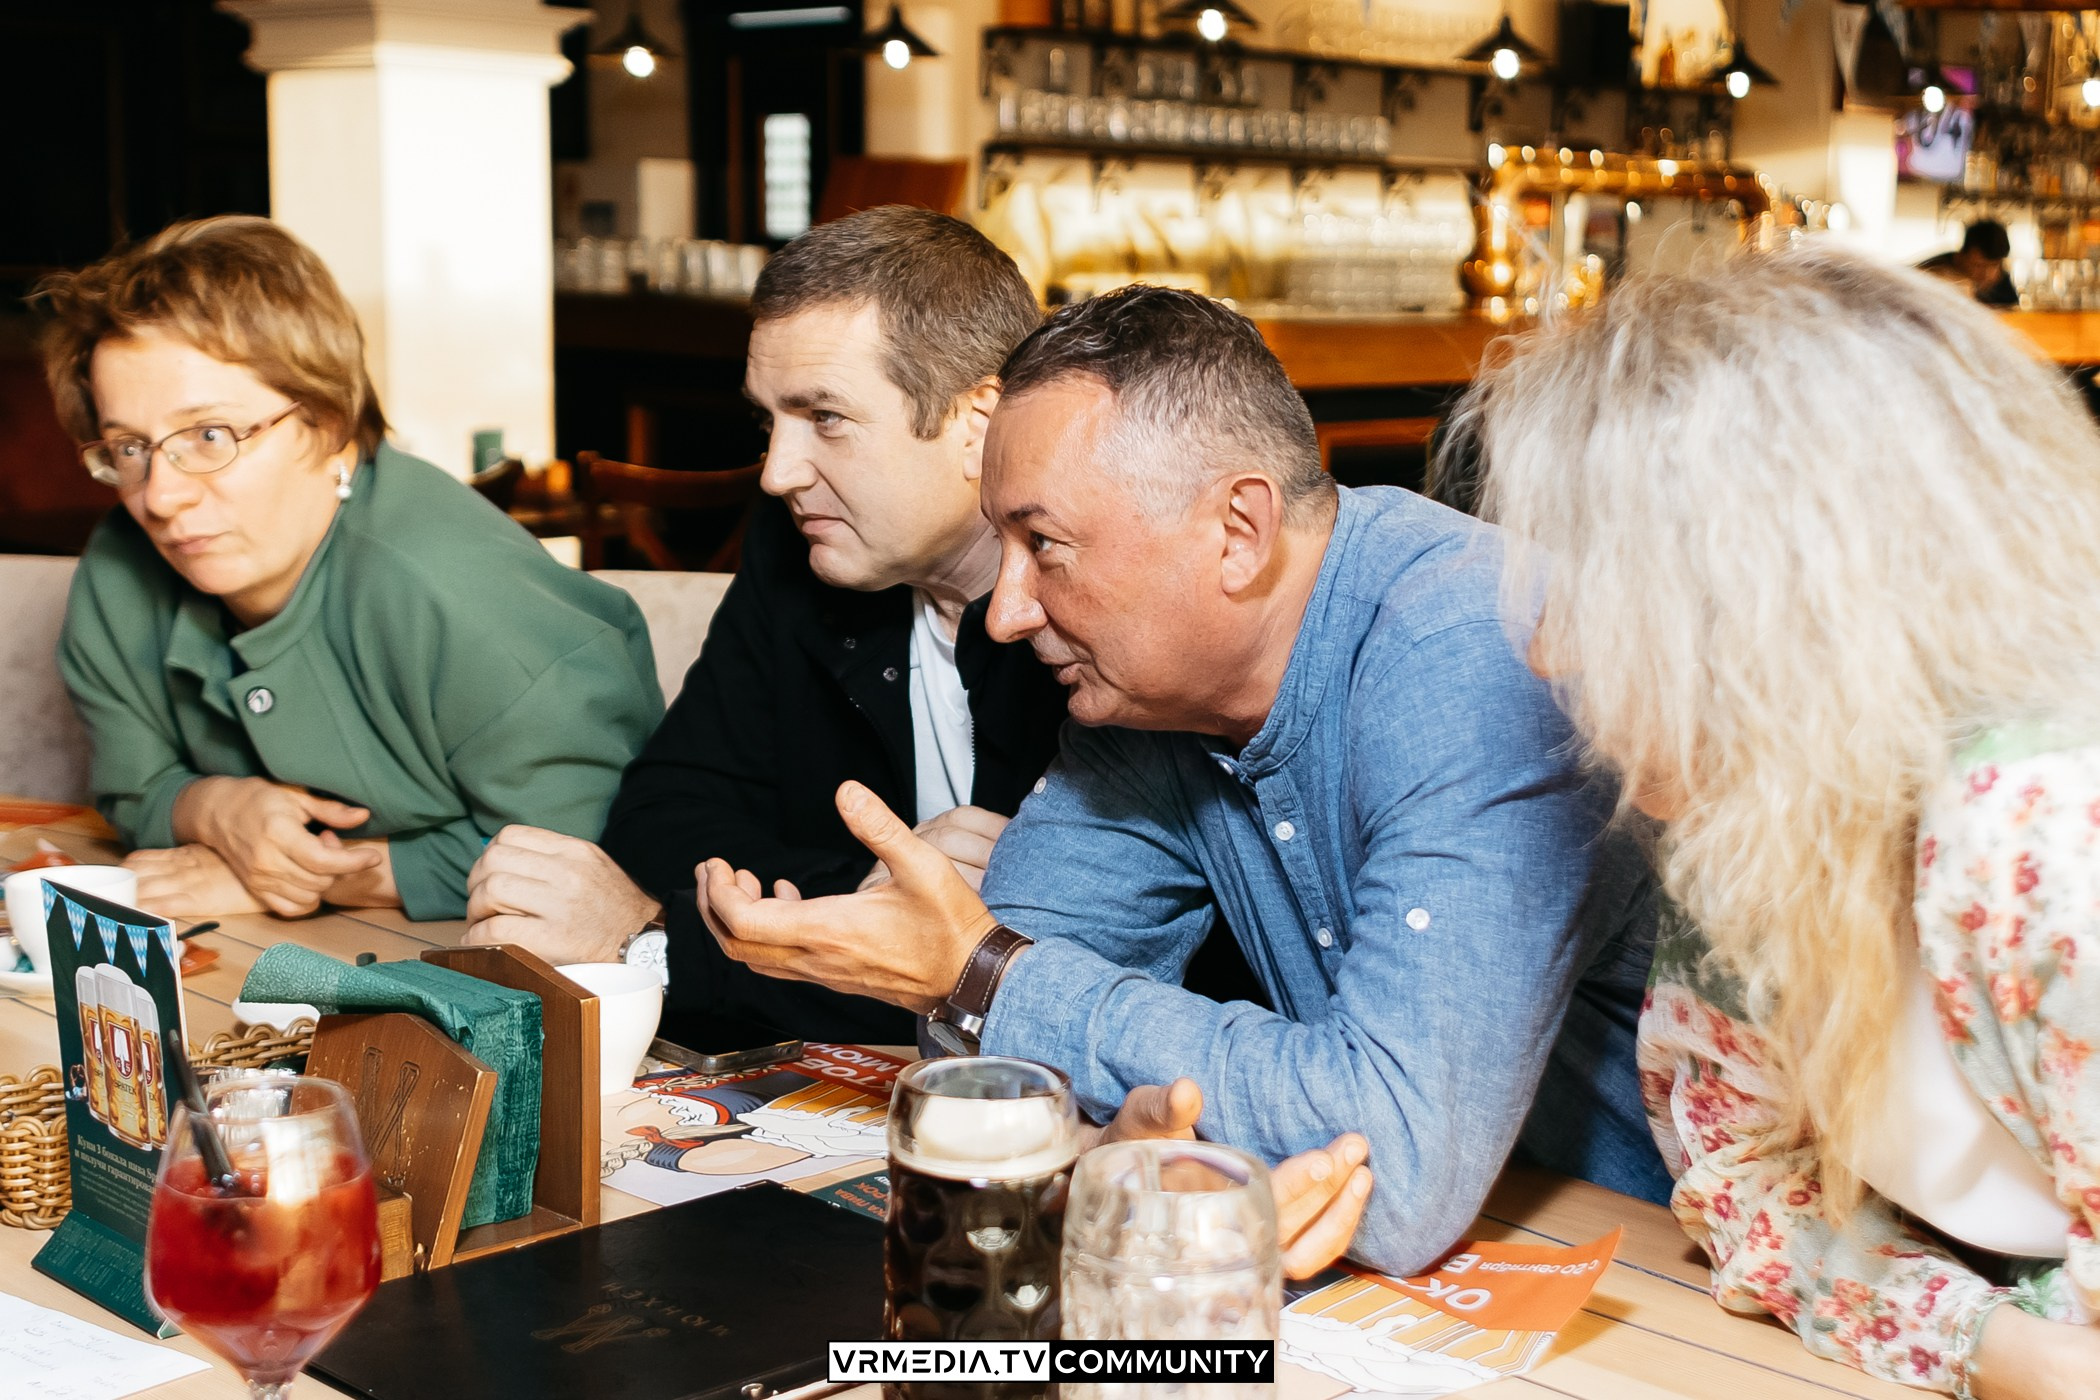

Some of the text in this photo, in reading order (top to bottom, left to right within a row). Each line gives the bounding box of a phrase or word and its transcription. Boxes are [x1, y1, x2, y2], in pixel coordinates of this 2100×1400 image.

[803, 1043, 900, 1072] МЮН
[793, 1055, 893, 1093] КТОБ
[77, 1134, 97, 1154] Купи
[102, 1146, 127, 1167] бокала
[128, 1160, 146, 1176] пива
[146, 1168, 158, 1184] Sp
[80, 1151, 107, 1170] получи
[1478, 1260, 1560, 1275] сентября
[1560, 1261, 1589, 1275] 20
